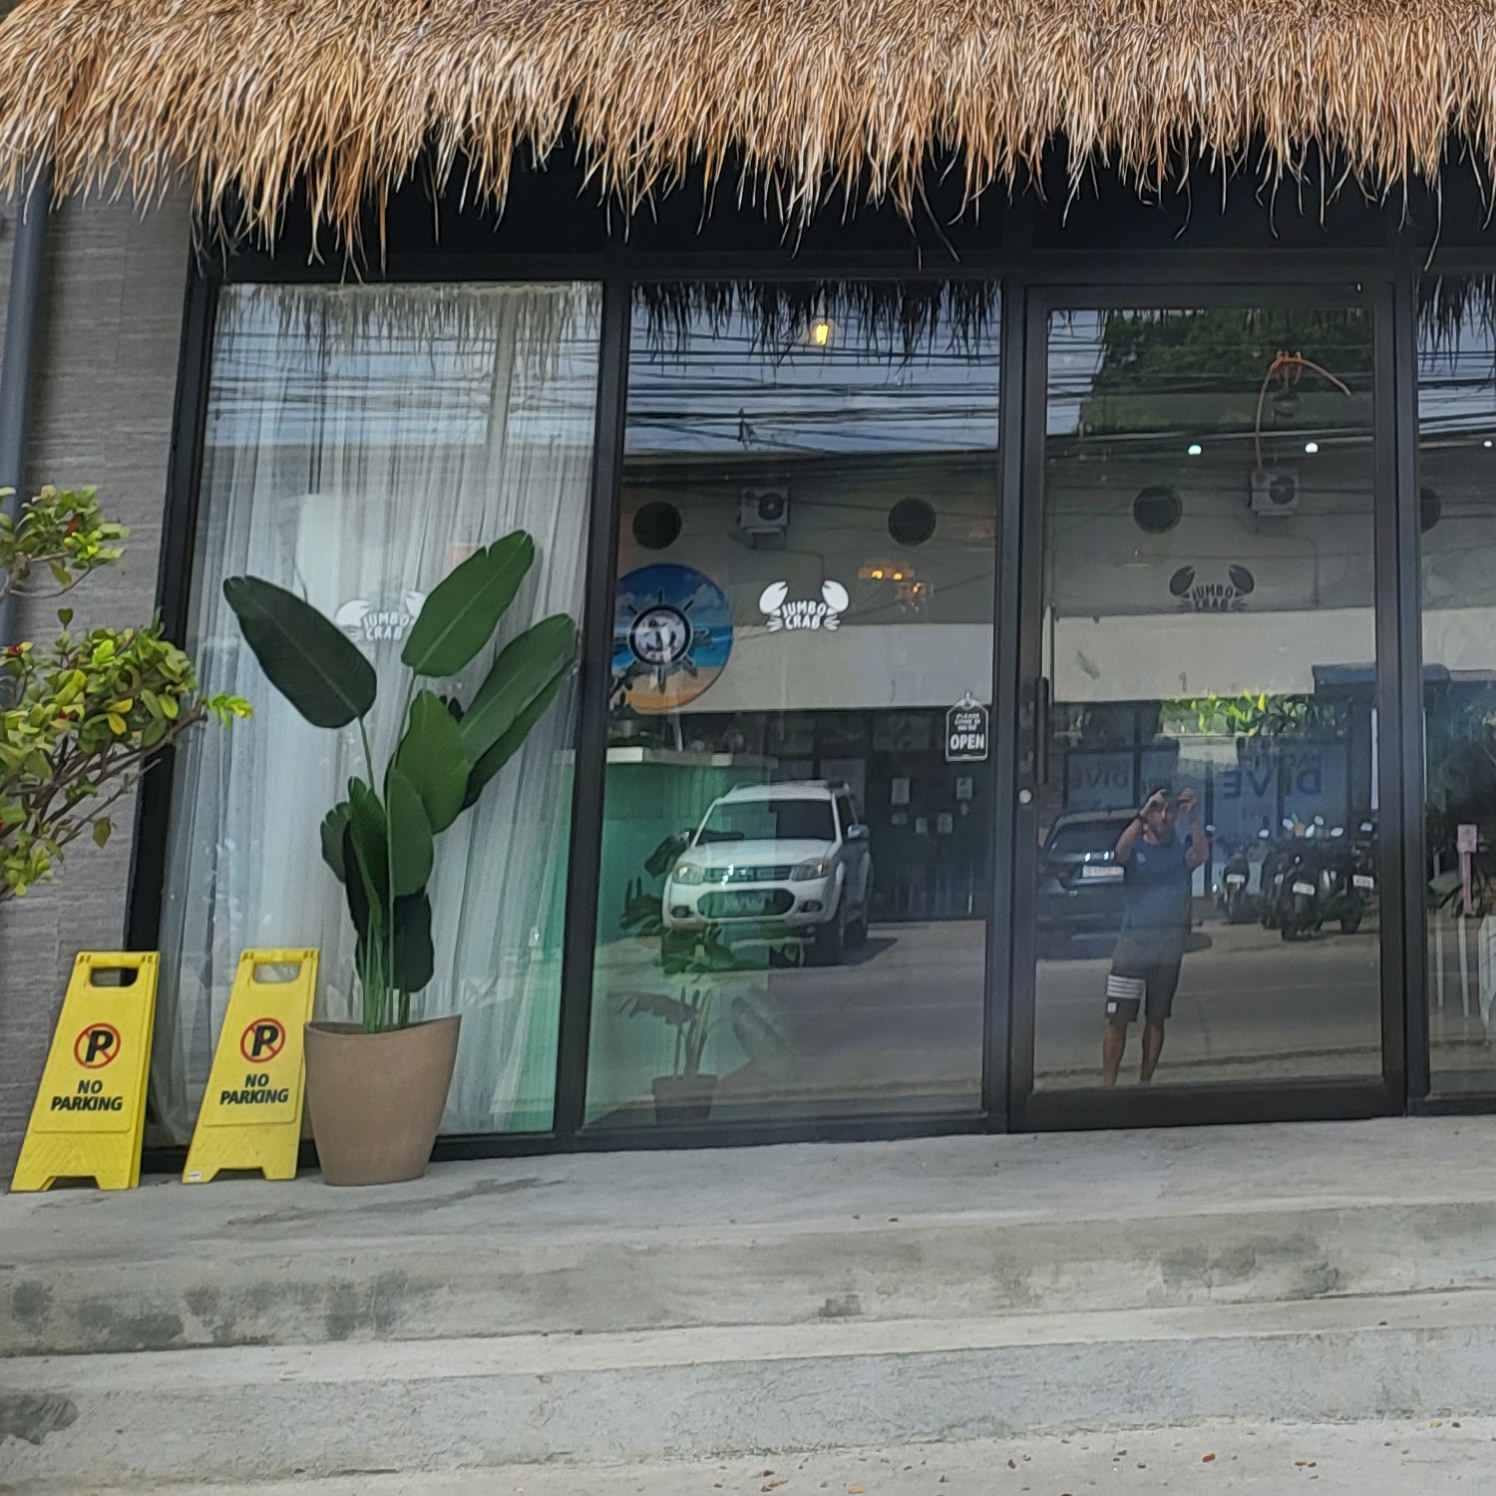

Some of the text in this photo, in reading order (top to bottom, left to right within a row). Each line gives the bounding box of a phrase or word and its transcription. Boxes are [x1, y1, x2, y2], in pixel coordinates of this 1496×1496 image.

[1192, 584, 1234, 600] JUMBO
[782, 600, 827, 618] JUMBO
[363, 611, 411, 630] JUMBO
[785, 614, 821, 630] CRAB
[366, 625, 404, 641] CRAB
[950, 733, 985, 750] OPEN
[77, 1079, 103, 1095] NO
[244, 1073, 270, 1088] NO
[50, 1095, 123, 1112] PARKING
[219, 1088, 289, 1106] PARKING
